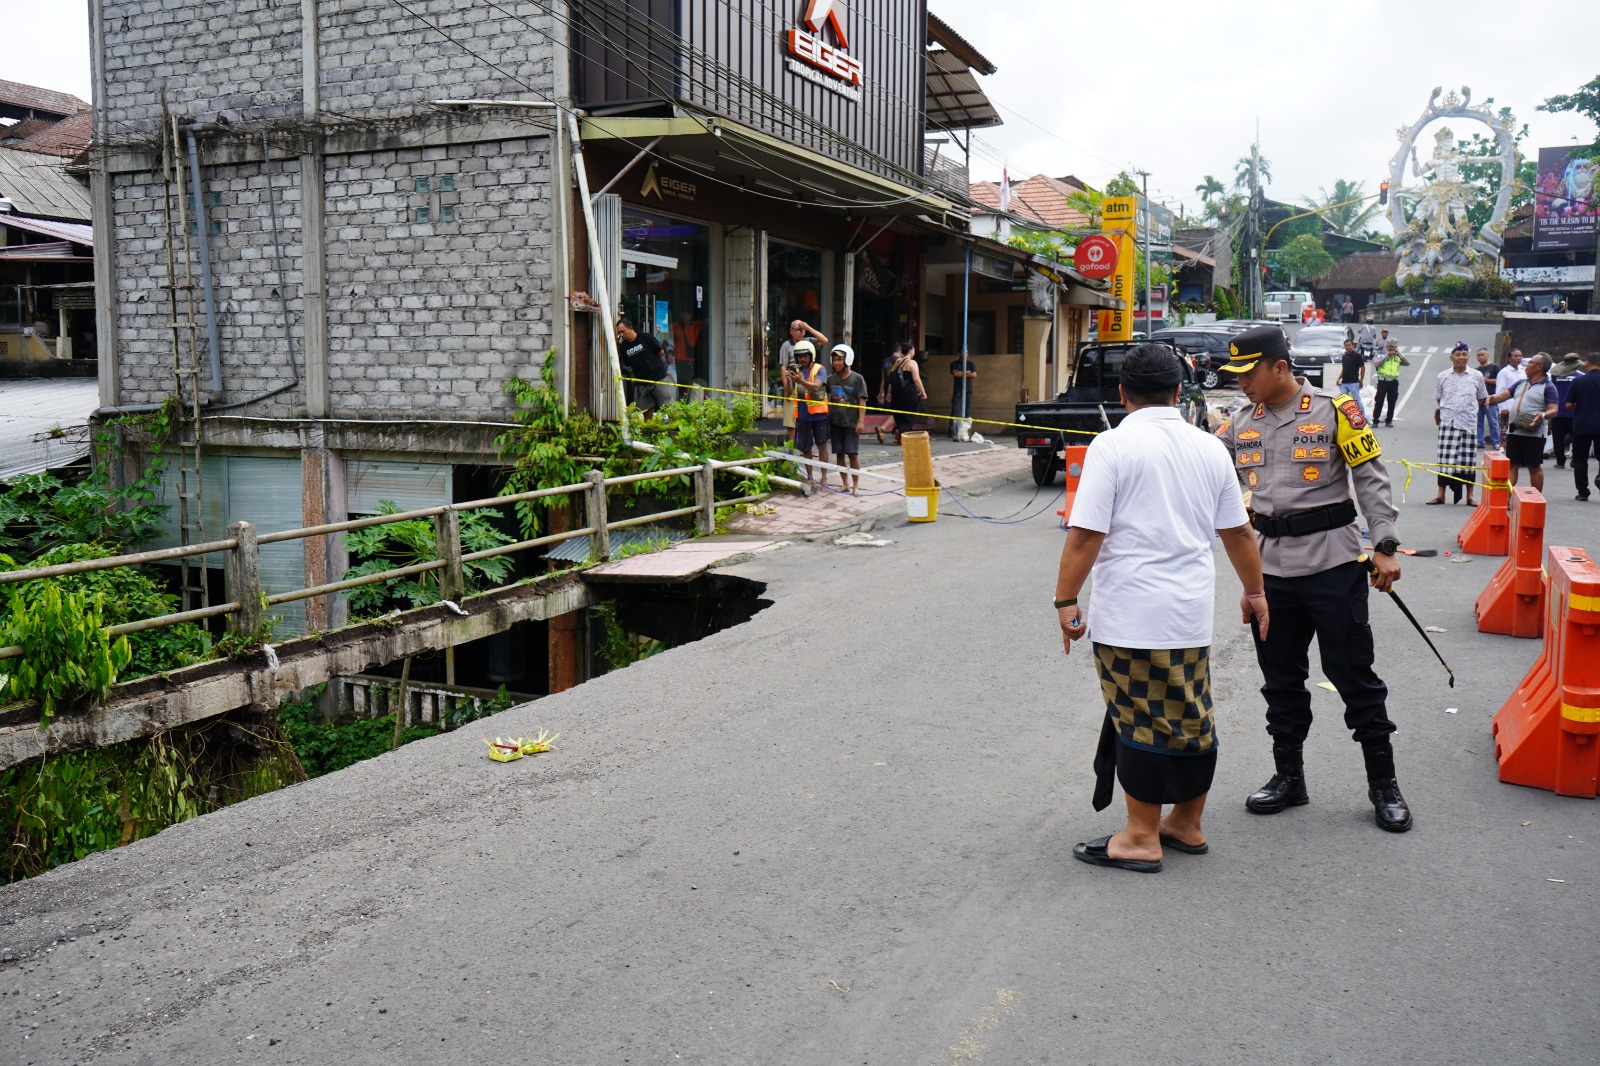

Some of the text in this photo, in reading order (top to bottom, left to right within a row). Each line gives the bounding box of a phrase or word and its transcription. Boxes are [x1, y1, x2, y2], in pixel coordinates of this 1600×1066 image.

[790, 28, 864, 87] EIGER
[789, 59, 862, 103] TROPICAL ADVENTURE
[661, 176, 696, 195] EIGER
[1106, 202, 1129, 213] atm
[1080, 262, 1110, 272] gofood
[1110, 274, 1123, 332] Danmon
[1235, 440, 1263, 450] CHANDRA
[1293, 434, 1329, 444] POLRI
[1343, 441, 1362, 462] KA
